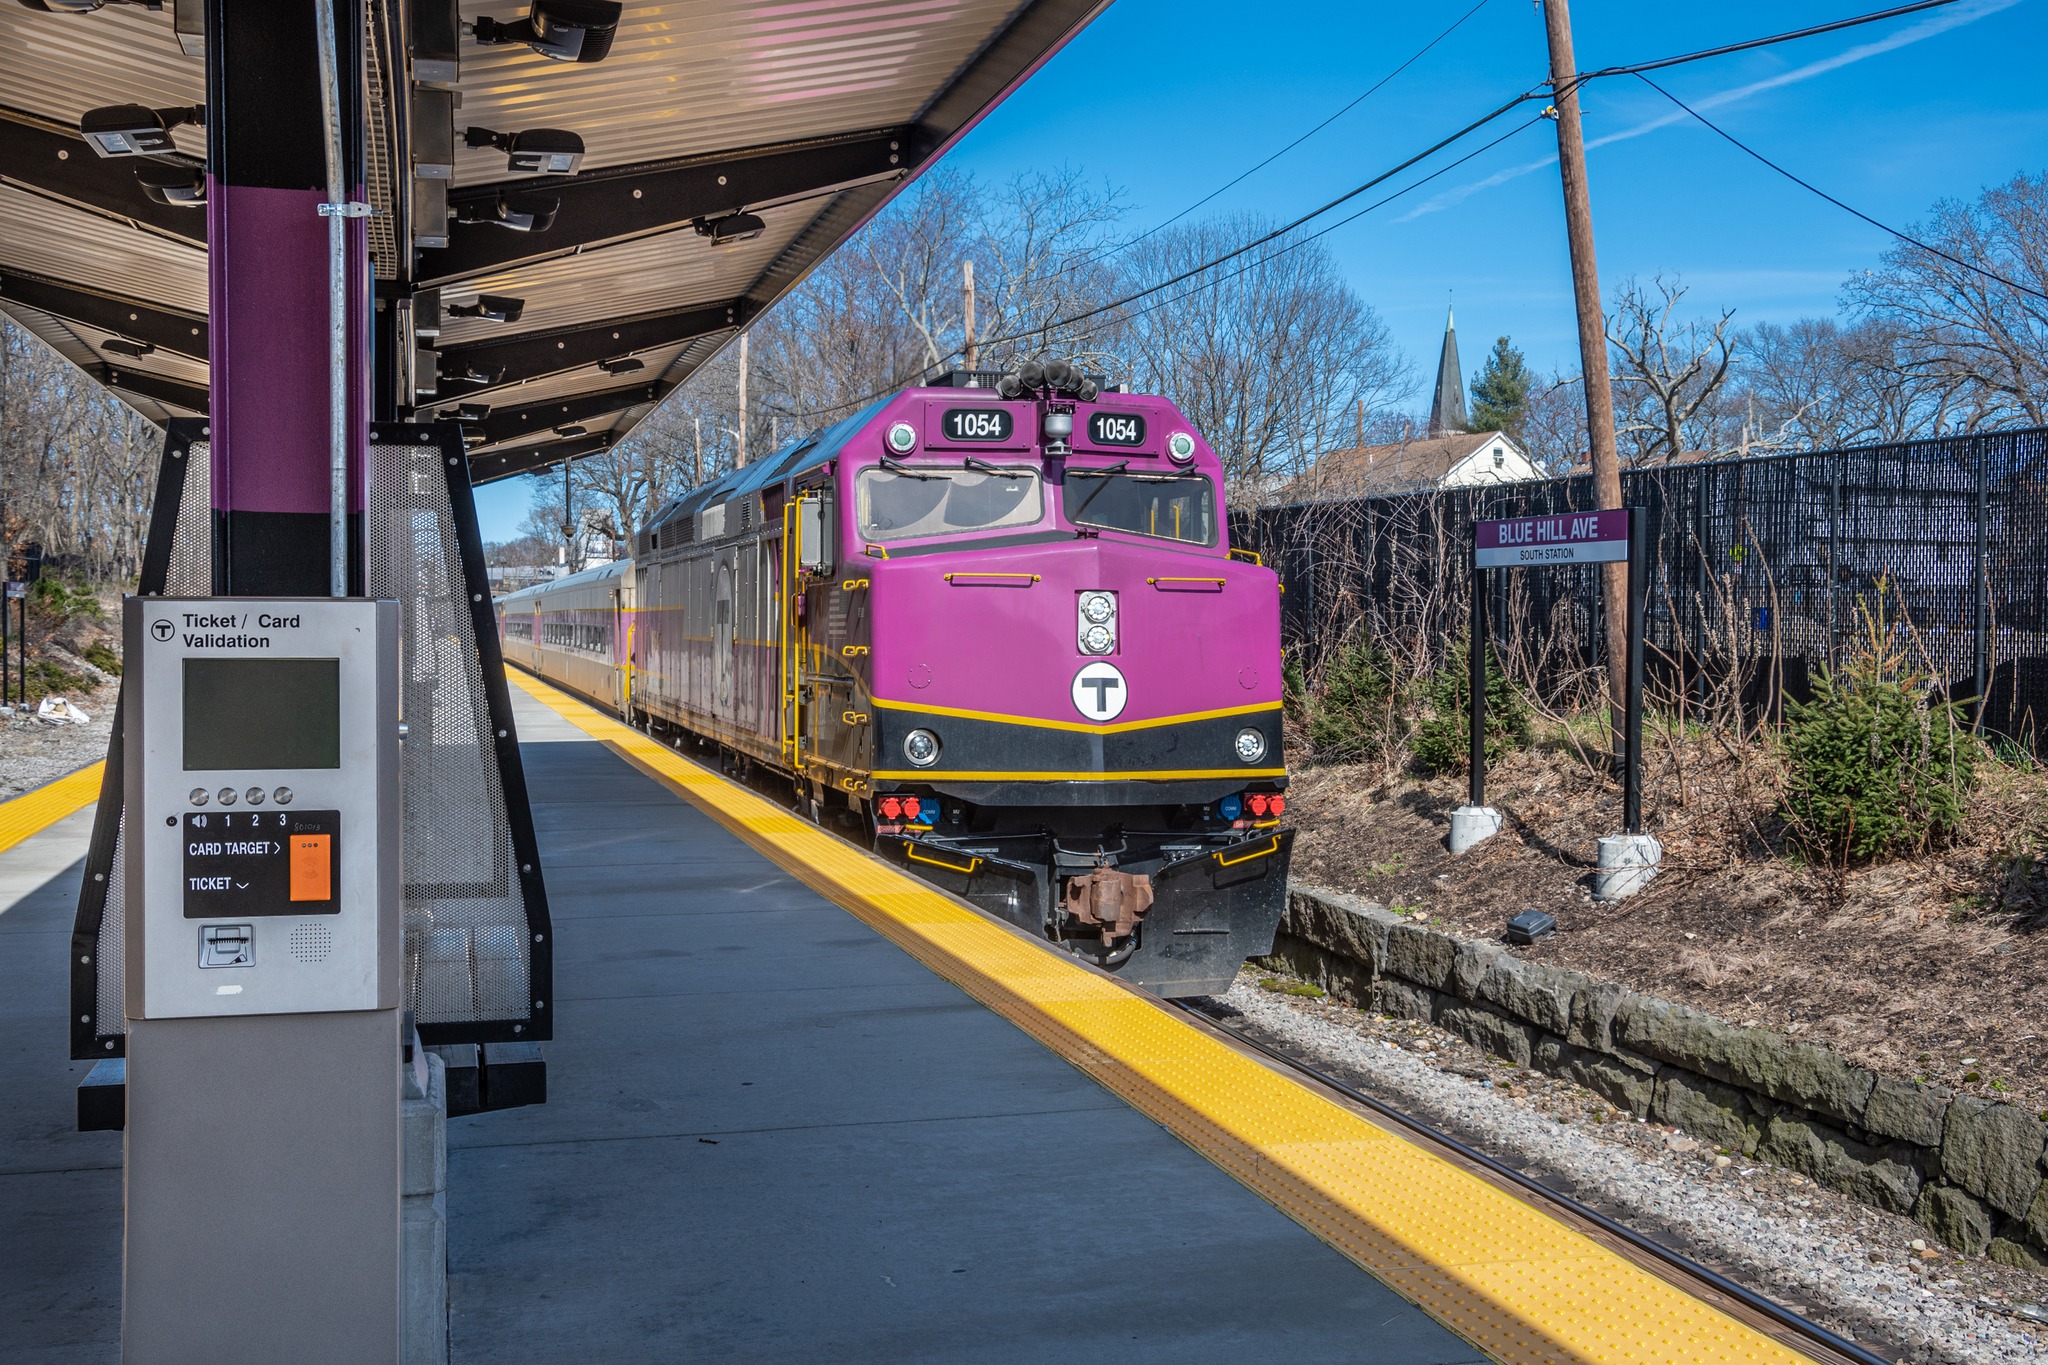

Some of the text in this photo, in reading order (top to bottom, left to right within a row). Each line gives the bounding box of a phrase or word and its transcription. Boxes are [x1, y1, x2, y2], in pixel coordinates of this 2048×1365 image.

[953, 414, 1001, 436] 1054
[1097, 417, 1136, 441] 1054
[1499, 516, 1598, 544] BLUE HILL AVE
[1520, 547, 1574, 561] SOUTH STATION
[183, 613, 300, 629] Ticket / Card
[183, 634, 270, 648] Validation
[1081, 677, 1119, 712] T
[225, 814, 286, 826] 1 2 3
[189, 841, 270, 856] CARD TARGET
[189, 877, 231, 890] TICKET
